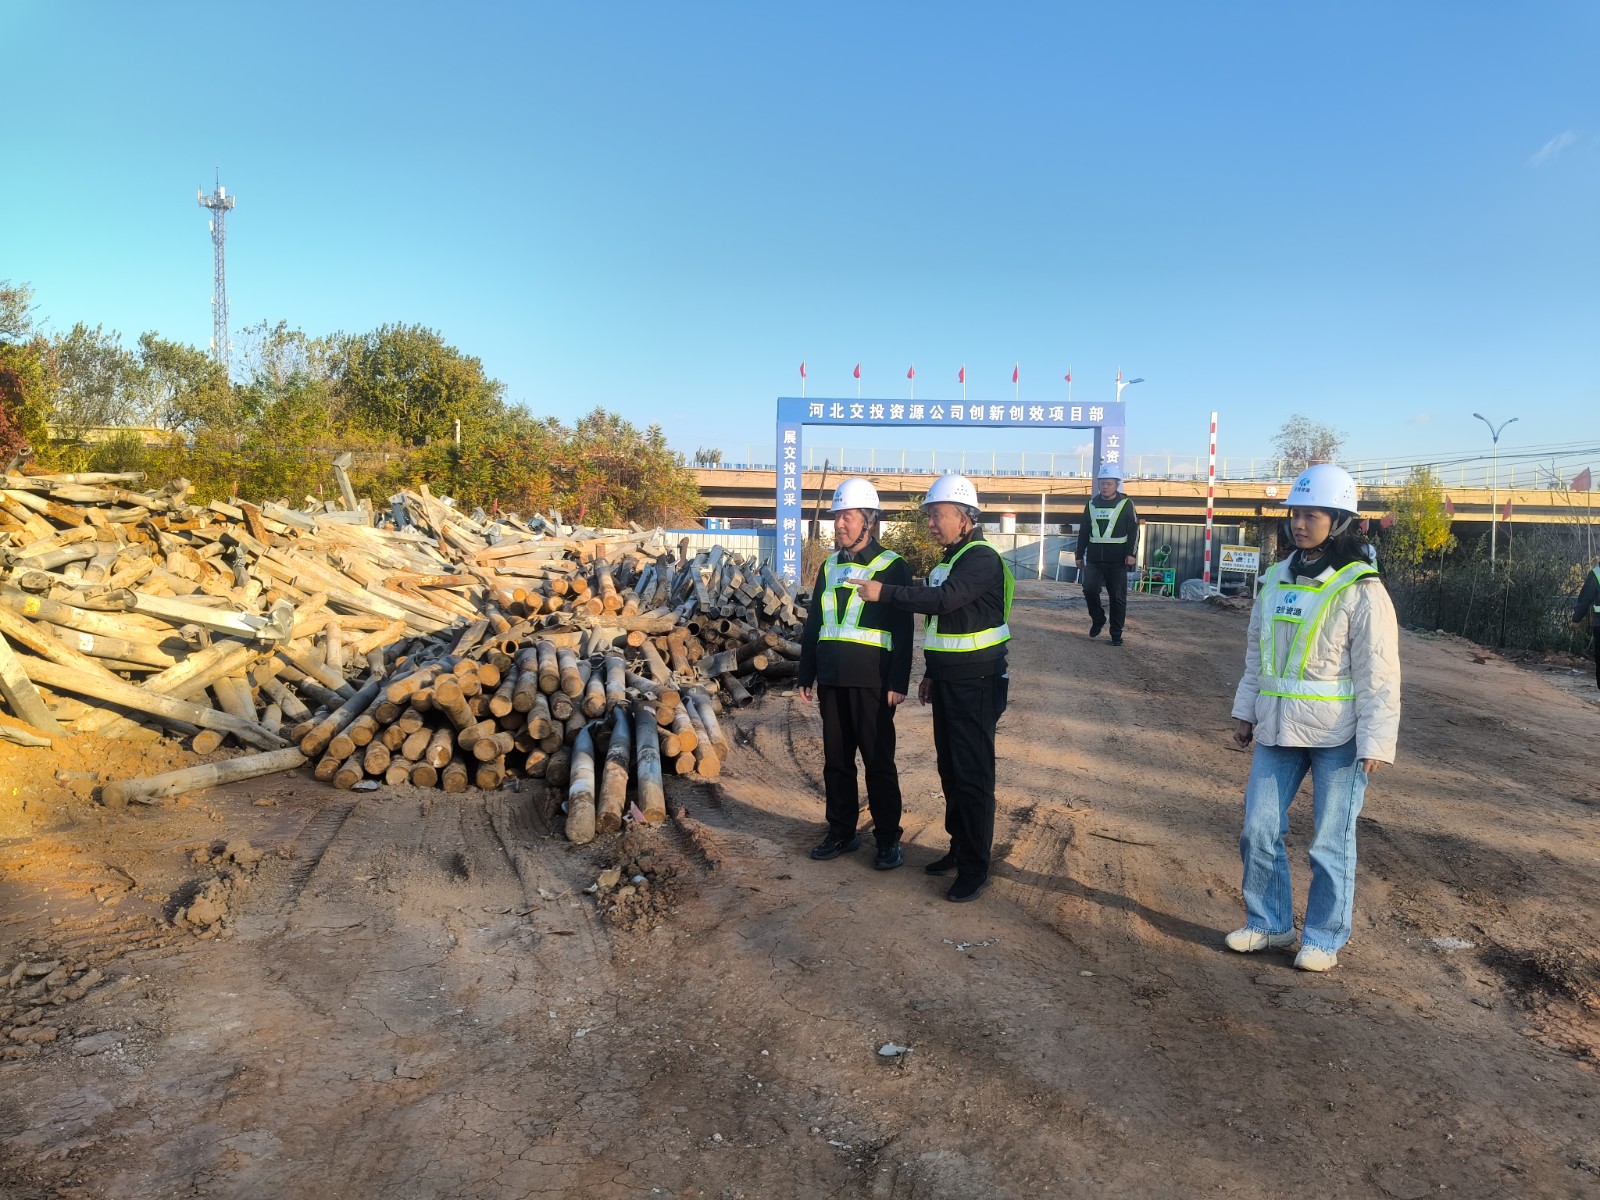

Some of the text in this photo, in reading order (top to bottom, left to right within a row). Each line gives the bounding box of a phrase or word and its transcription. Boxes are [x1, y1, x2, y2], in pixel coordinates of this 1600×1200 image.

[808, 402, 1105, 422] 河北交投资源公司创新创效项目部
[1106, 434, 1120, 468] 立资
[783, 430, 797, 507] 展交投风采
